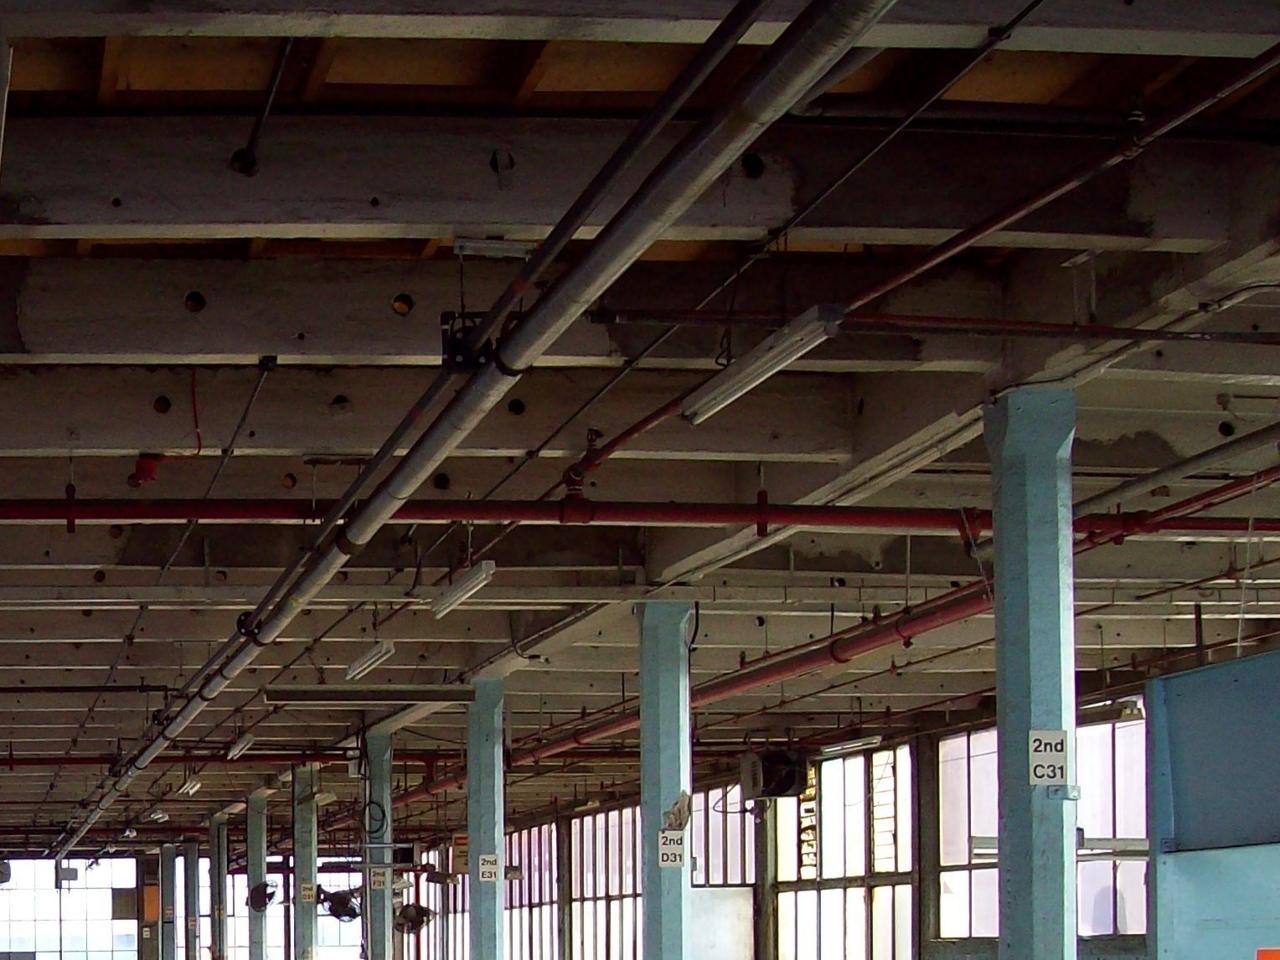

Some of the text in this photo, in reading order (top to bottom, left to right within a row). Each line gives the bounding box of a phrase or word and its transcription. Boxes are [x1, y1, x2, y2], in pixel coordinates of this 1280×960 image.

[1033, 738, 1064, 753] 2nd
[1033, 764, 1064, 779] C31
[661, 836, 683, 846] 2nd
[481, 857, 497, 866] 2nd
[661, 852, 682, 863] D31
[481, 871, 497, 879] E31
